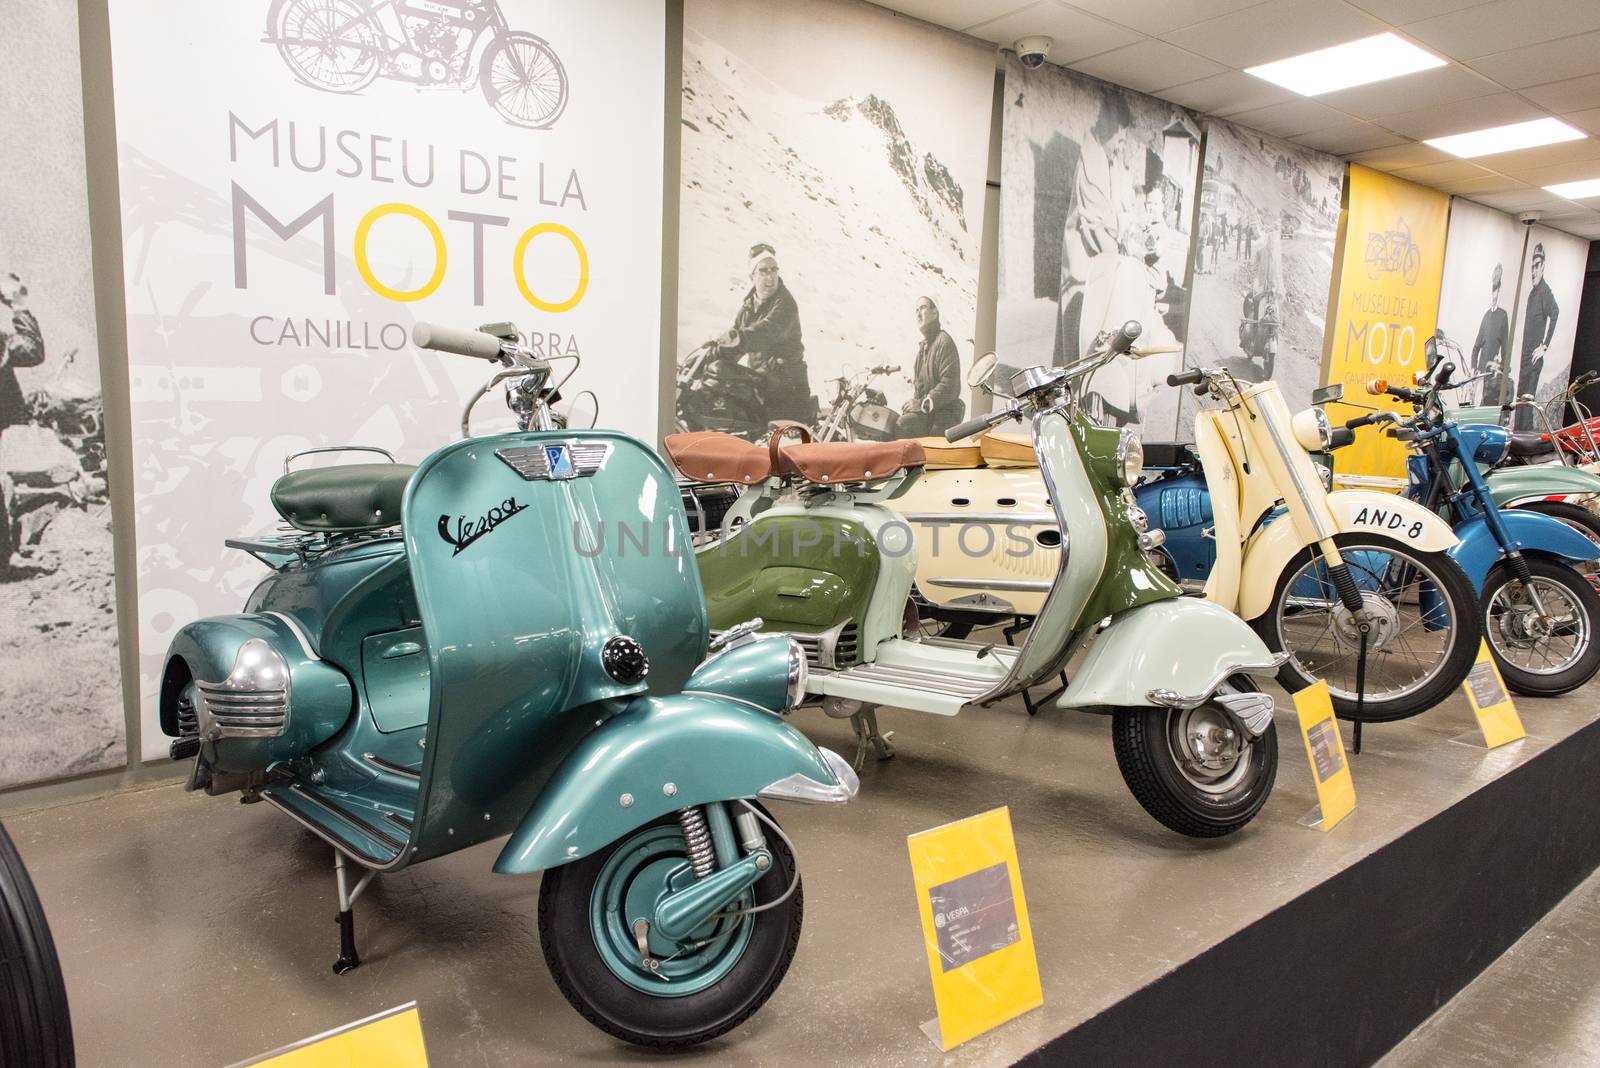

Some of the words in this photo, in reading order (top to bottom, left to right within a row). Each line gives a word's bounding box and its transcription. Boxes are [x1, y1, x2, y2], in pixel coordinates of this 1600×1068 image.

[229, 109, 434, 188] MUSEU
[460, 149, 518, 201] DE
[539, 162, 588, 211] LA
[231, 178, 589, 313] MOTO
[1352, 291, 1391, 316] MUSEU
[1393, 297, 1407, 318] DE
[1408, 300, 1419, 319] LA
[250, 315, 407, 351] CANILLO
[1345, 320, 1415, 366] MOTO
[438, 497, 529, 557] Vespa
[1353, 507, 1423, 539] AND-8
[946, 906, 970, 921] VESPA
